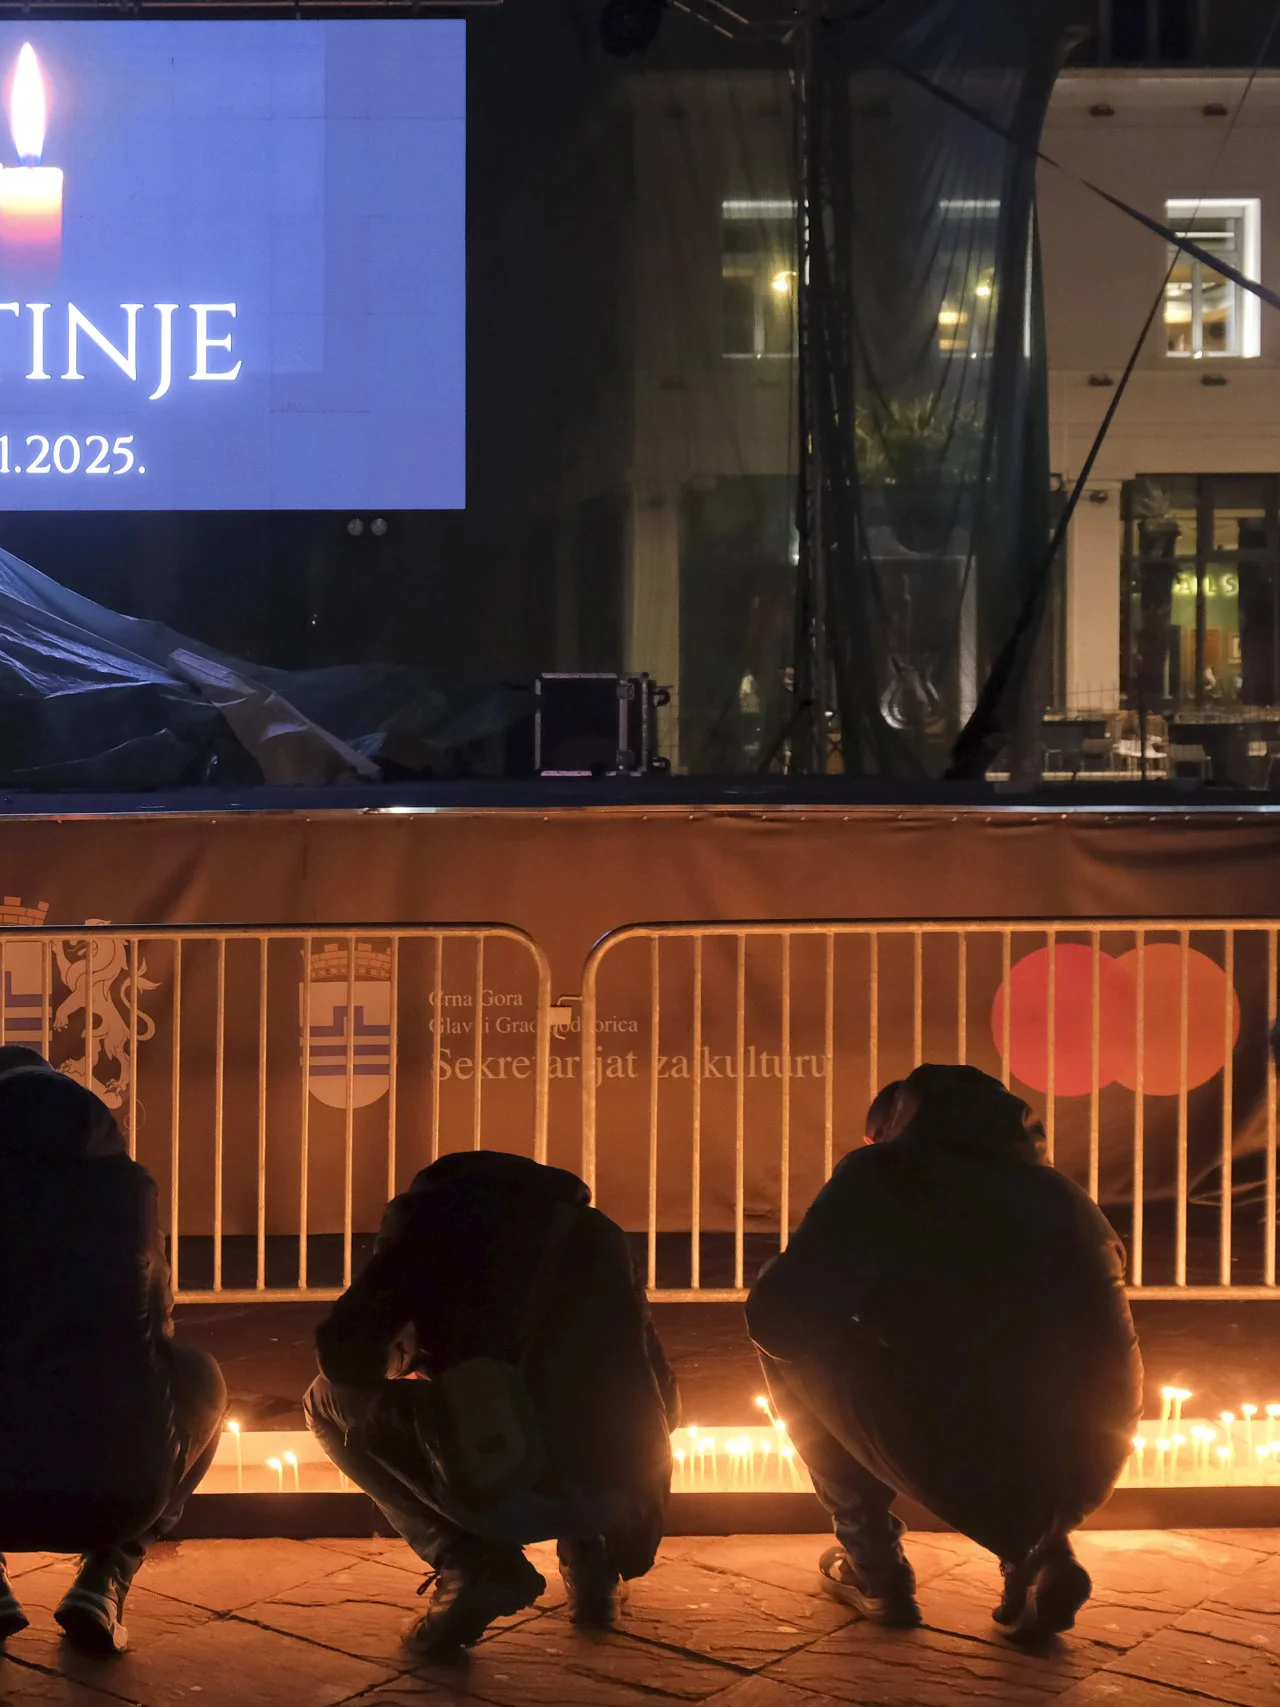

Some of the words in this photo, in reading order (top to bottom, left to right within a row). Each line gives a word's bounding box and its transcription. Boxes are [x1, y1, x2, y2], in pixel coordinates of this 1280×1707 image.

[428, 990, 473, 1007] Crna
[481, 989, 524, 1007] Gora
[428, 1016, 490, 1034] Glavi
[549, 1015, 638, 1033] odorica
[430, 1046, 639, 1088] Sekrearjat
[656, 1055, 691, 1079] za
[701, 1045, 832, 1079] kulturu
